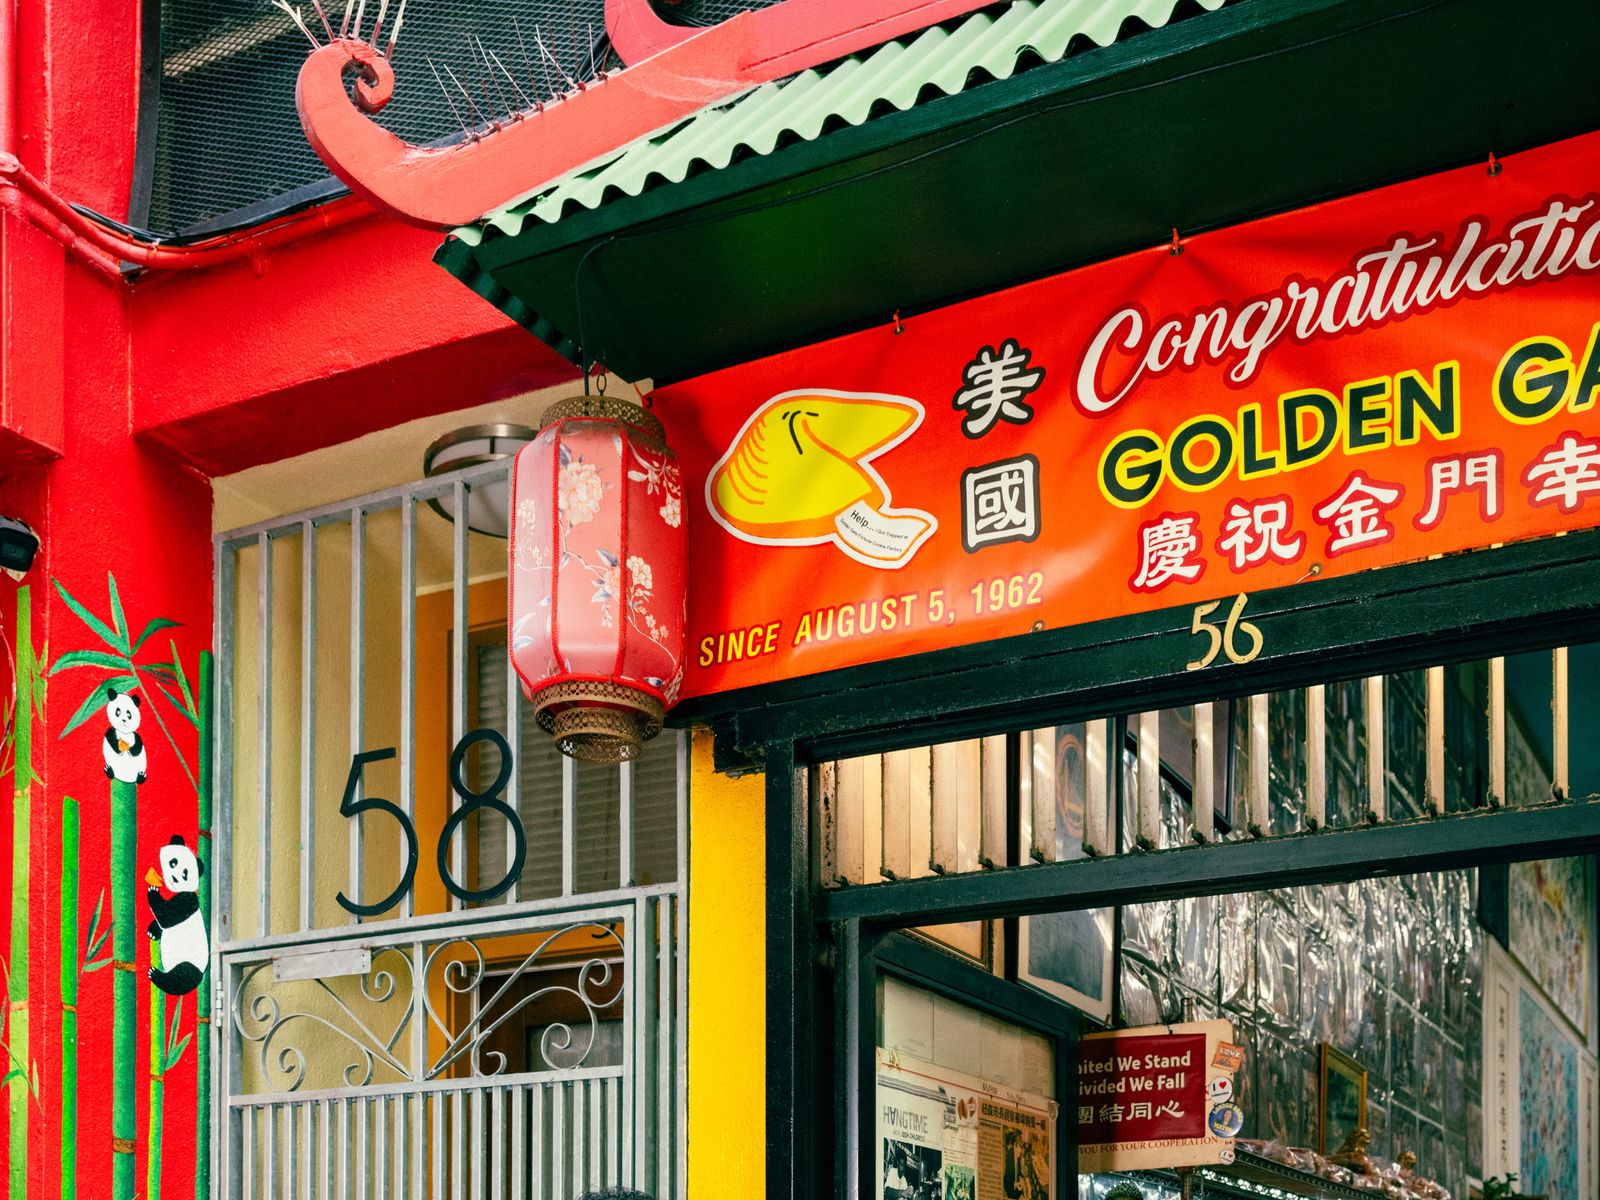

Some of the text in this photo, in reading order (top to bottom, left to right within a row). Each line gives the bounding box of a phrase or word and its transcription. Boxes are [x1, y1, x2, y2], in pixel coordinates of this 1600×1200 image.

[954, 340, 1045, 552] 美國
[1099, 361, 1459, 508] GOLDEN
[850, 510, 874, 531] Help...
[699, 571, 1044, 668] SINCE AUGUST 5, 1962
[1186, 592, 1263, 671] 56
[336, 728, 527, 917] 58
[1078, 1050, 1191, 1075] ited We Stand
[1079, 1072, 1185, 1096] ivided We Fall
[883, 1105, 928, 1134] HANGTIME
[1100, 1144, 1119, 1153] FOR
[1120, 1142, 1146, 1152] YOUR
[1148, 1136, 1218, 1149] COOPERATION
